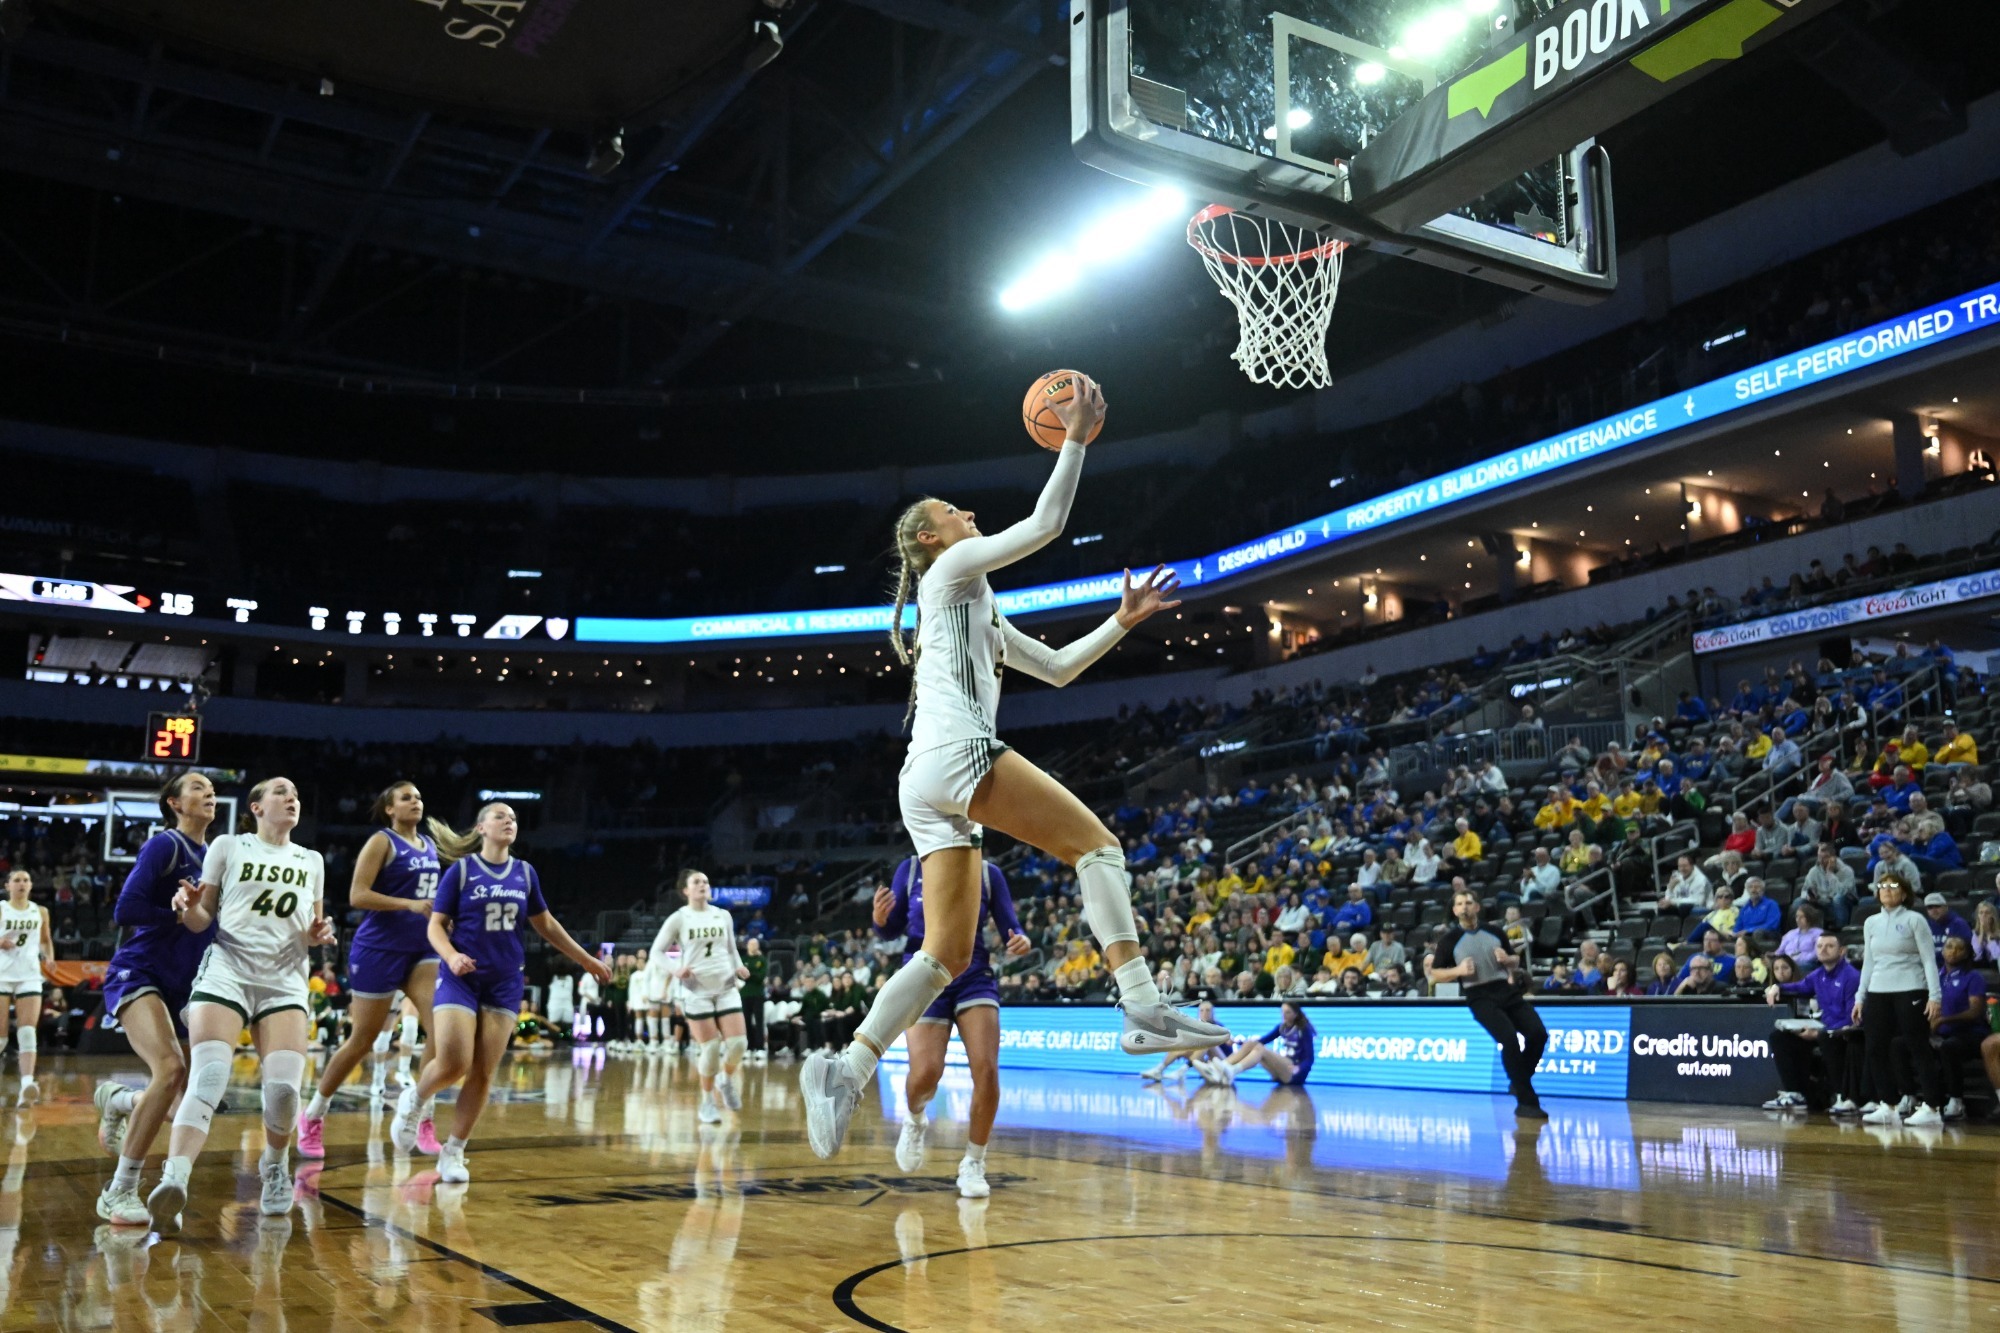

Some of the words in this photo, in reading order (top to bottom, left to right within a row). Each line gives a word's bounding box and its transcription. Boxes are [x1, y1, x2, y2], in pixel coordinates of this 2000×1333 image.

[691, 616, 790, 637] COMMERCIAL
[795, 616, 806, 630] &
[809, 611, 906, 629] RESIDENTIA
[1218, 530, 1306, 572] DESIGN/BUILD
[1346, 489, 1423, 529] PROPERTY
[1427, 484, 1438, 502] &
[1441, 458, 1519, 498] BUILDING
[1521, 409, 1658, 471] MAINTENANCE
[1735, 309, 1954, 400] SELF-PERFORMED
[1959, 294, 2000, 323] TR
[1730, 627, 1761, 643] LIGHT
[1770, 617, 1807, 636] COLD
[1808, 609, 1849, 630] ZONE
[1866, 594, 1908, 616] Coors
[1909, 589, 1947, 607] LIGHT
[154, 731, 190, 757] 27
[239, 862, 308, 888] BISON
[415, 873, 438, 899] 52
[251, 889, 299, 918] 40
[485, 902, 519, 931] 22
[5, 918, 39, 931] BISON
[689, 927, 725, 941] BISON
[15, 933, 28, 947] 8
[704, 942, 713, 957] 1
[1046, 1030, 1072, 1049] OUR
[1072, 1031, 1118, 1051] LATEST
[1318, 1034, 1468, 1062] JANSCORP.COM
[1633, 1033, 1699, 1057] Credit
[1701, 1034, 1769, 1058] Union
[1535, 1059, 1597, 1075] EALTH
